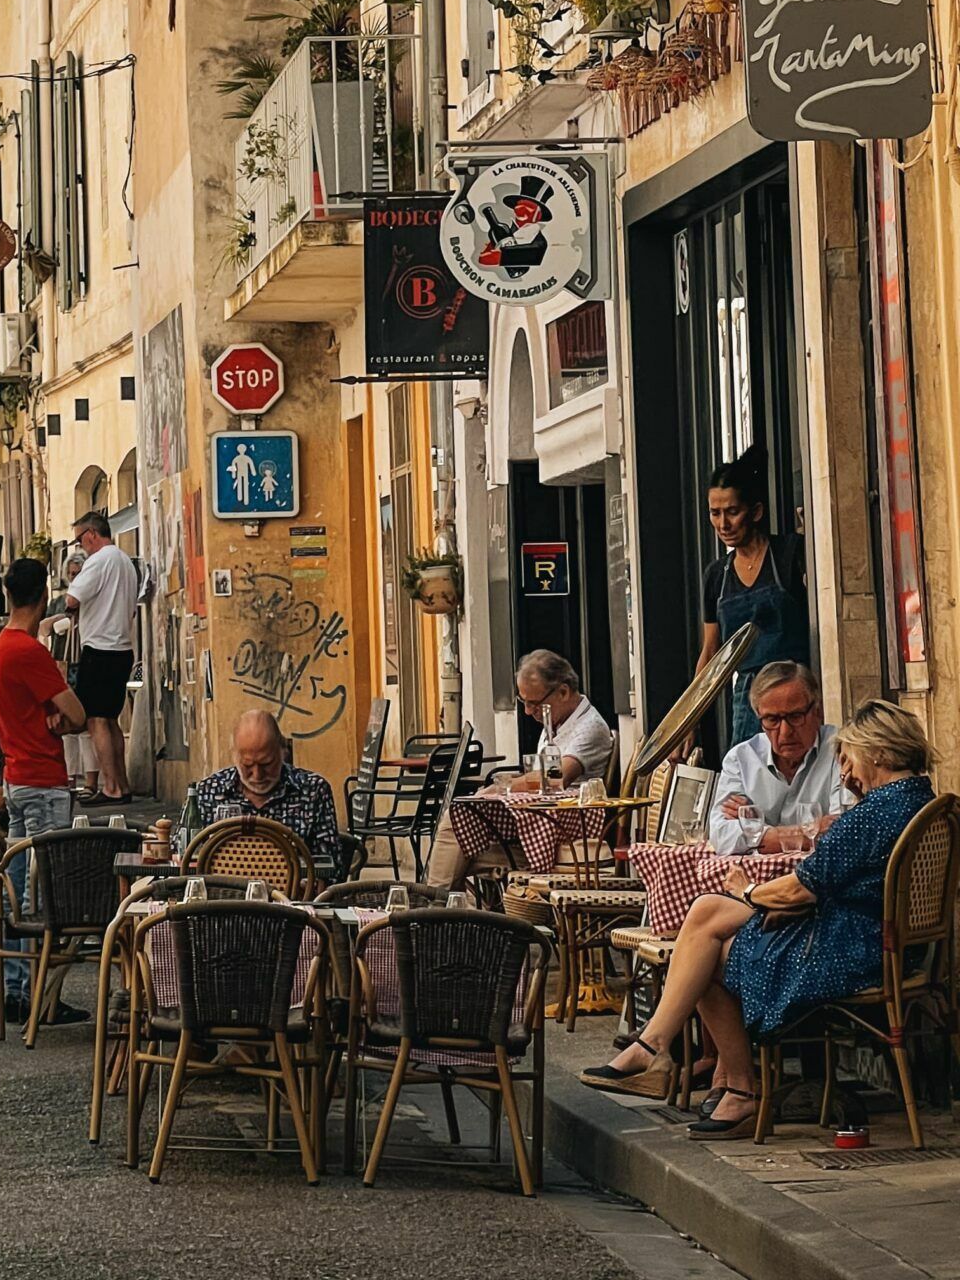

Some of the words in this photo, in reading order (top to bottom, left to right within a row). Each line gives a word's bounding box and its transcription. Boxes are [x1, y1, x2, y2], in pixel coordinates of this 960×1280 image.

[492, 168, 504, 176] LA
[505, 162, 558, 178] CHARCUTERIE
[449, 236, 485, 287] BOUCHON
[486, 276, 558, 299] CAMARGUAIS
[412, 277, 437, 307] B
[370, 354, 435, 363] restaurant
[451, 354, 486, 363] tapas
[222, 368, 274, 389] STOP
[534, 561, 556, 578] R
